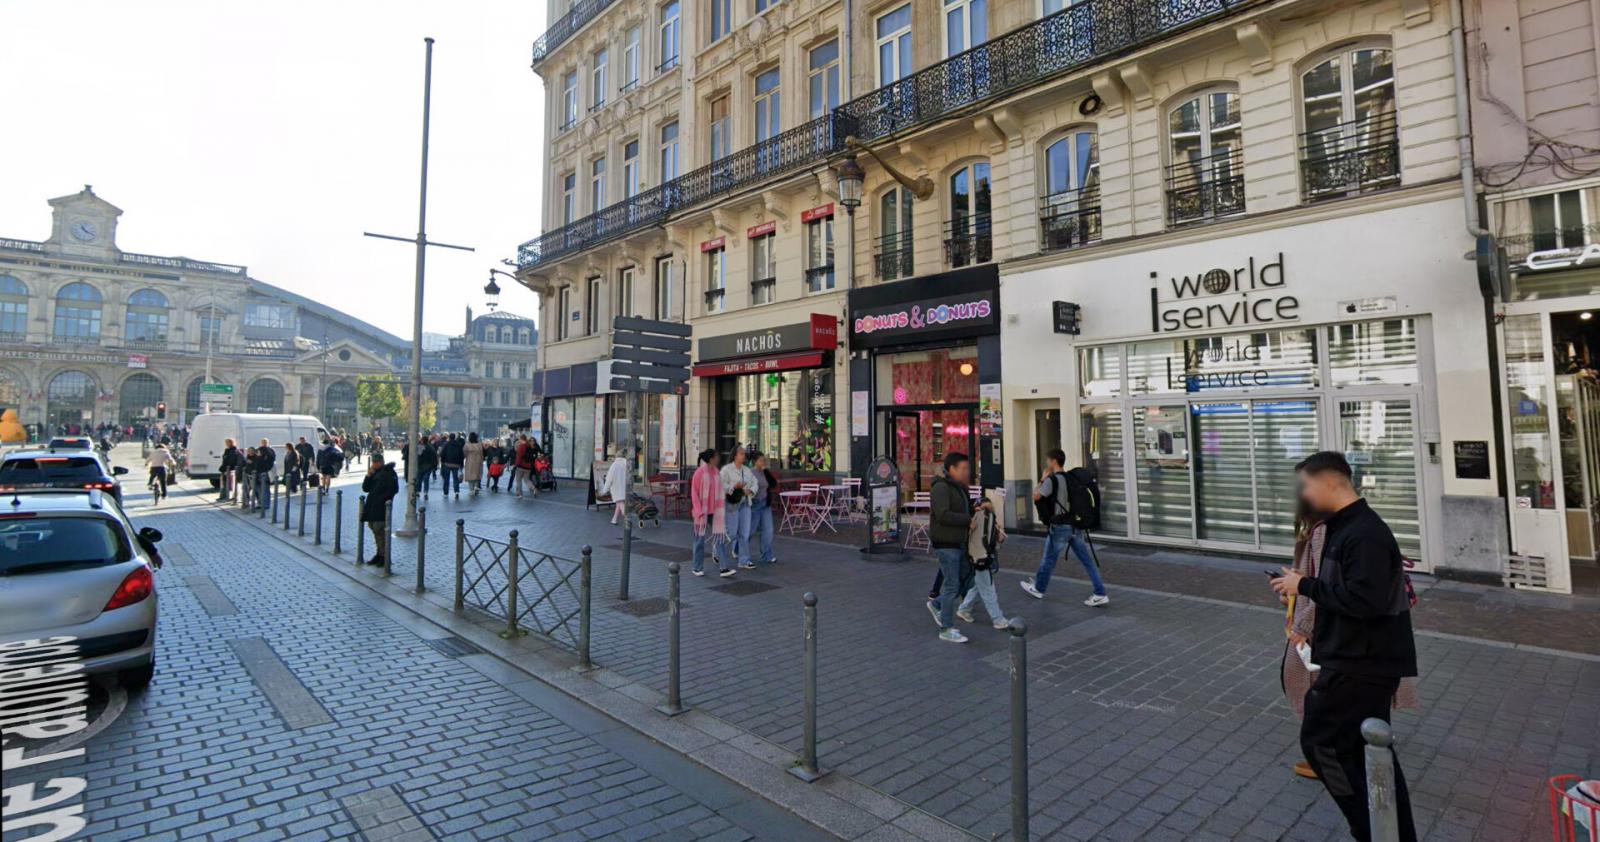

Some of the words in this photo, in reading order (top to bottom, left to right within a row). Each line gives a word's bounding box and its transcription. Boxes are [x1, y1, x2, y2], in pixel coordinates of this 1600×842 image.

[1171, 252, 1286, 299] world
[854, 310, 910, 334] DONUTS
[909, 304, 926, 329] &
[926, 299, 991, 325] DONUTS
[1162, 292, 1300, 332] service
